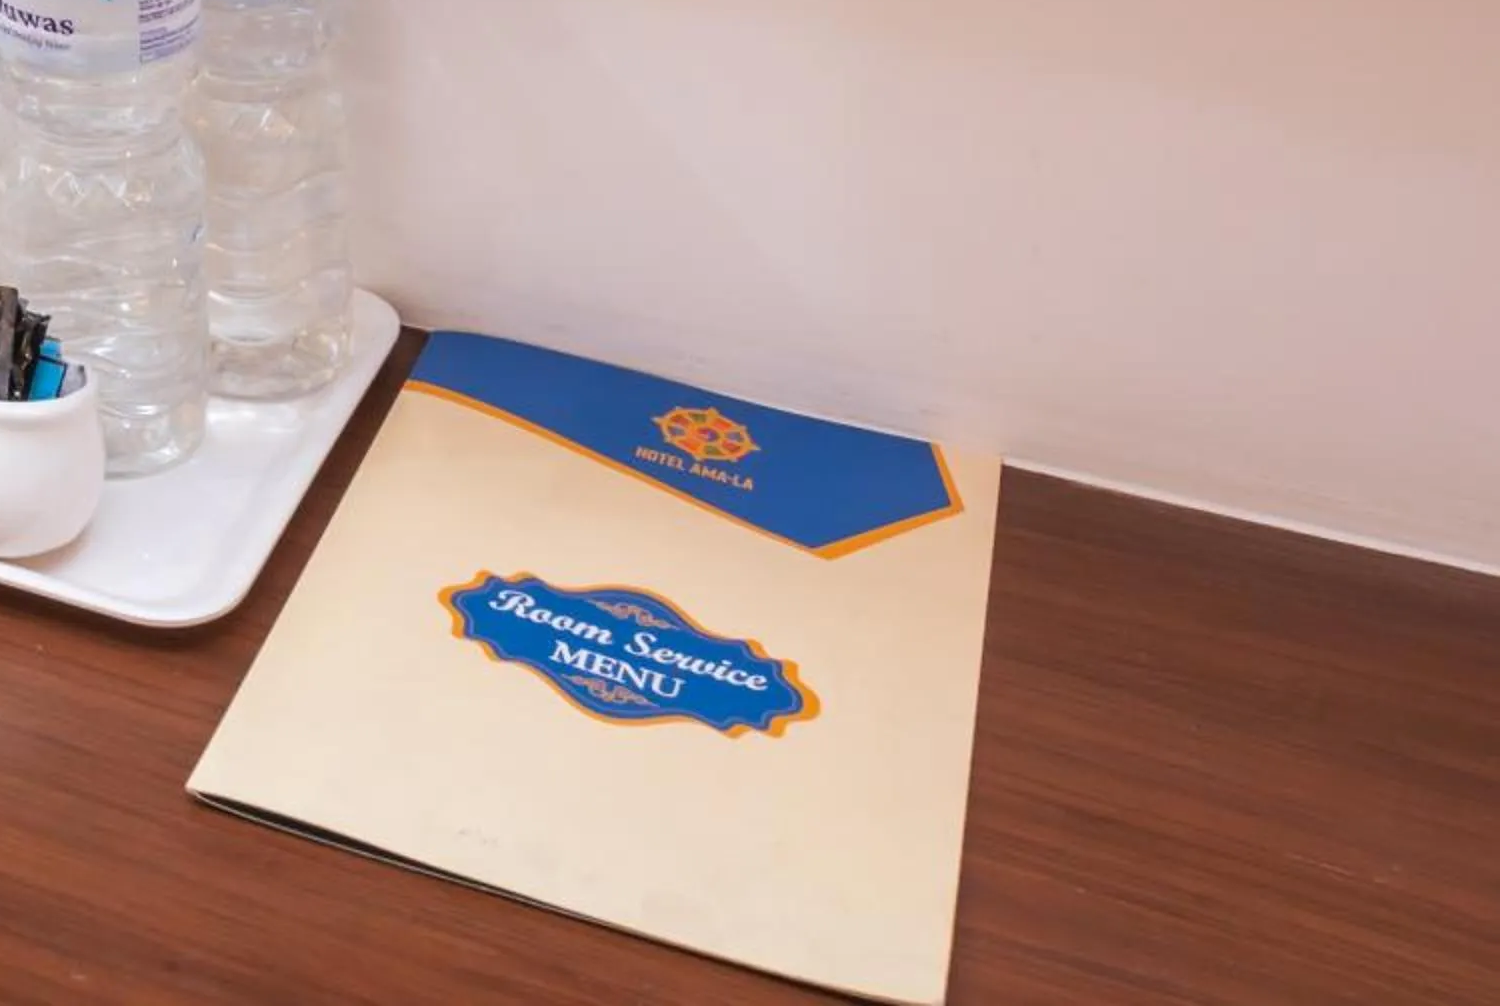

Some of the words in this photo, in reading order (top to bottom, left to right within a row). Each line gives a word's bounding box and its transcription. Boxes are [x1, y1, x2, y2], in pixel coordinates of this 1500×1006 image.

[635, 445, 684, 471] HOTEL
[488, 589, 615, 645] Room
[623, 631, 770, 691] Service
[549, 639, 687, 698] MENU
